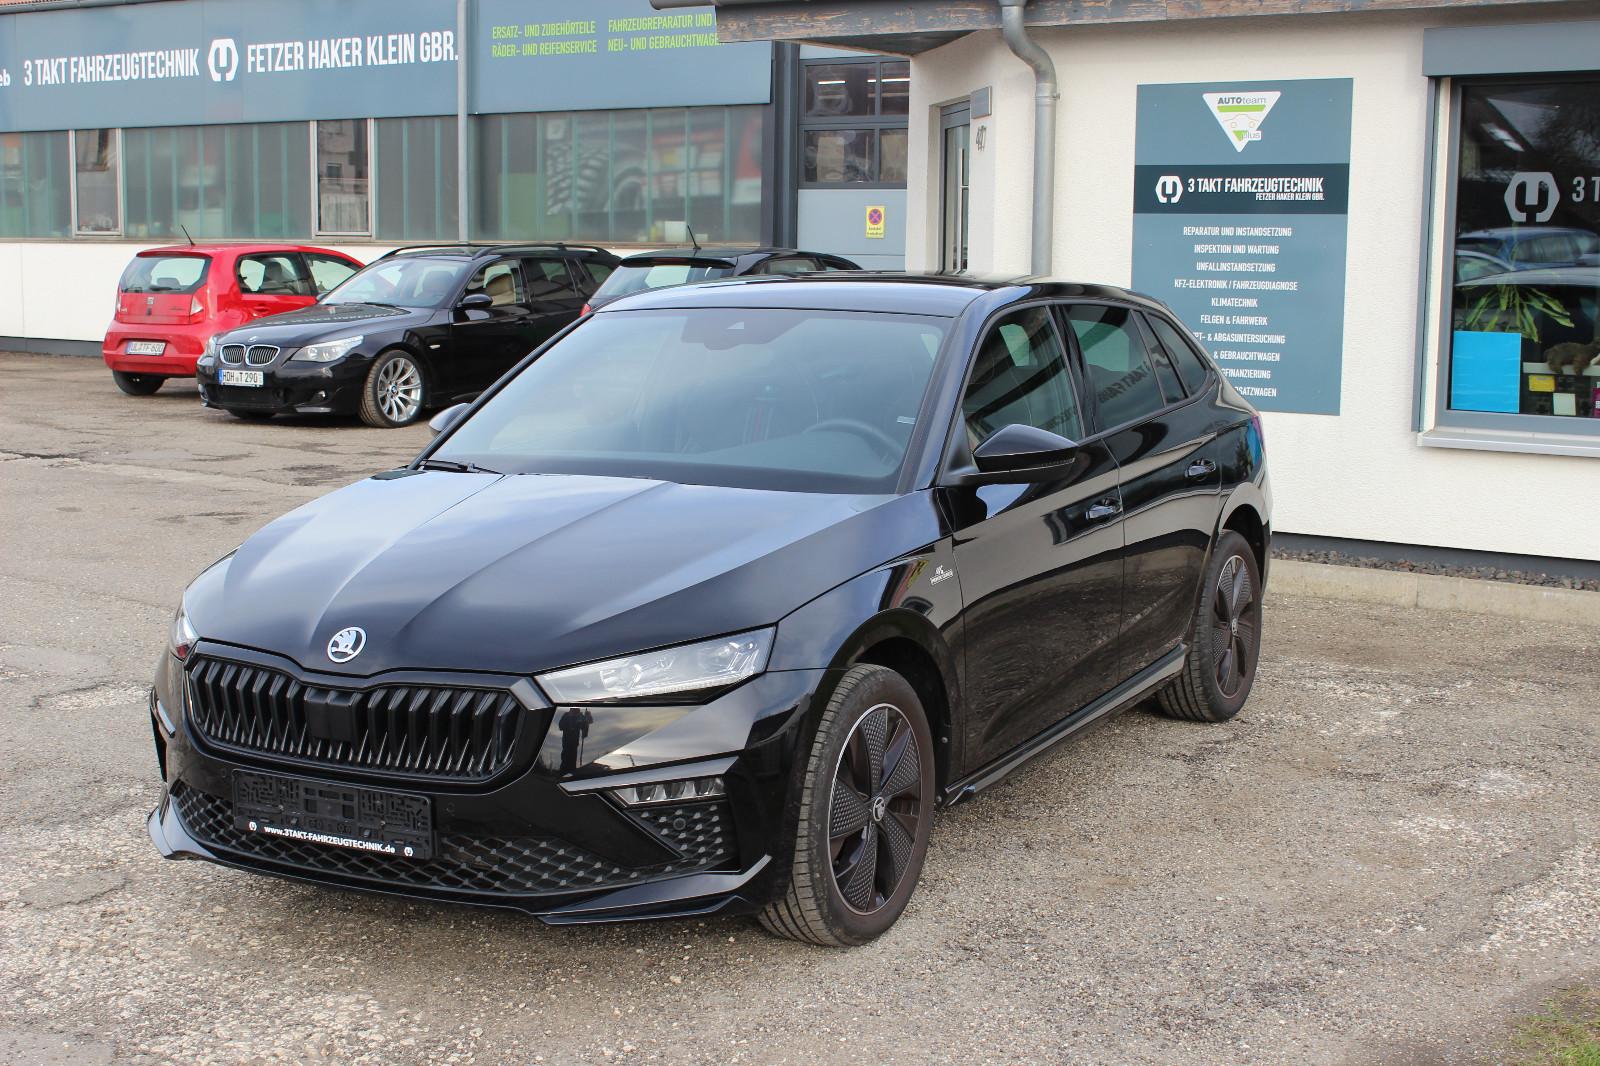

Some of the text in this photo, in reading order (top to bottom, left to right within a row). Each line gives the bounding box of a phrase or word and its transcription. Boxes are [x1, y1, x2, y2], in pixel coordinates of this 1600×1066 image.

[608, 13, 713, 32] FAHRZEUGREPARATUR UND
[492, 19, 596, 39] ERSATZ- UND ZUBEHÖRTEILE
[608, 33, 725, 52] NEU- UND GEBRAUCHTWAGE
[247, 30, 459, 73] FETZER HAKER KLEIN GBR.
[492, 42, 521, 57] RÄDER-
[522, 43, 538, 56] UND
[24, 48, 199, 86] 3 TAKT FAHRZEUGTECHNIK
[1217, 96, 1267, 105] AUTOteam
[1241, 131, 1261, 140] plus
[1187, 177, 1324, 193] 3 TAKT FAHRZEUGTECHNIK
[1572, 176, 1586, 202] 3
[1255, 193, 1276, 201] FETZER
[1276, 193, 1295, 201] HAKER
[1295, 193, 1312, 201] KLEIN
[1183, 226, 1292, 237] REPARATUR UND INSTANDSETZUNG
[1194, 244, 1279, 255] INSPEKTION UND WARTUNG
[1196, 262, 1276, 273] UNFALLINSTANDSETZUNG
[1174, 279, 1227, 289] KFZ-ELEKTRONIK
[1232, 280, 1298, 291] FAHRZEUGDIAGNOSE
[1211, 297, 1258, 308] KLIMATECHNIK
[1200, 315, 1268, 326] FELGEN & FAHRWERK
[1207, 333, 1213, 341] &
[1213, 333, 1286, 344] ABGASUNTERSUCHUNG
[1213, 350, 1280, 361] & GEBRAUCHTWAGEN
[244, 372, 258, 383] 290
[263, 825, 396, 854] www.3TAKT-FAHRZEUGTECHNIK.de
